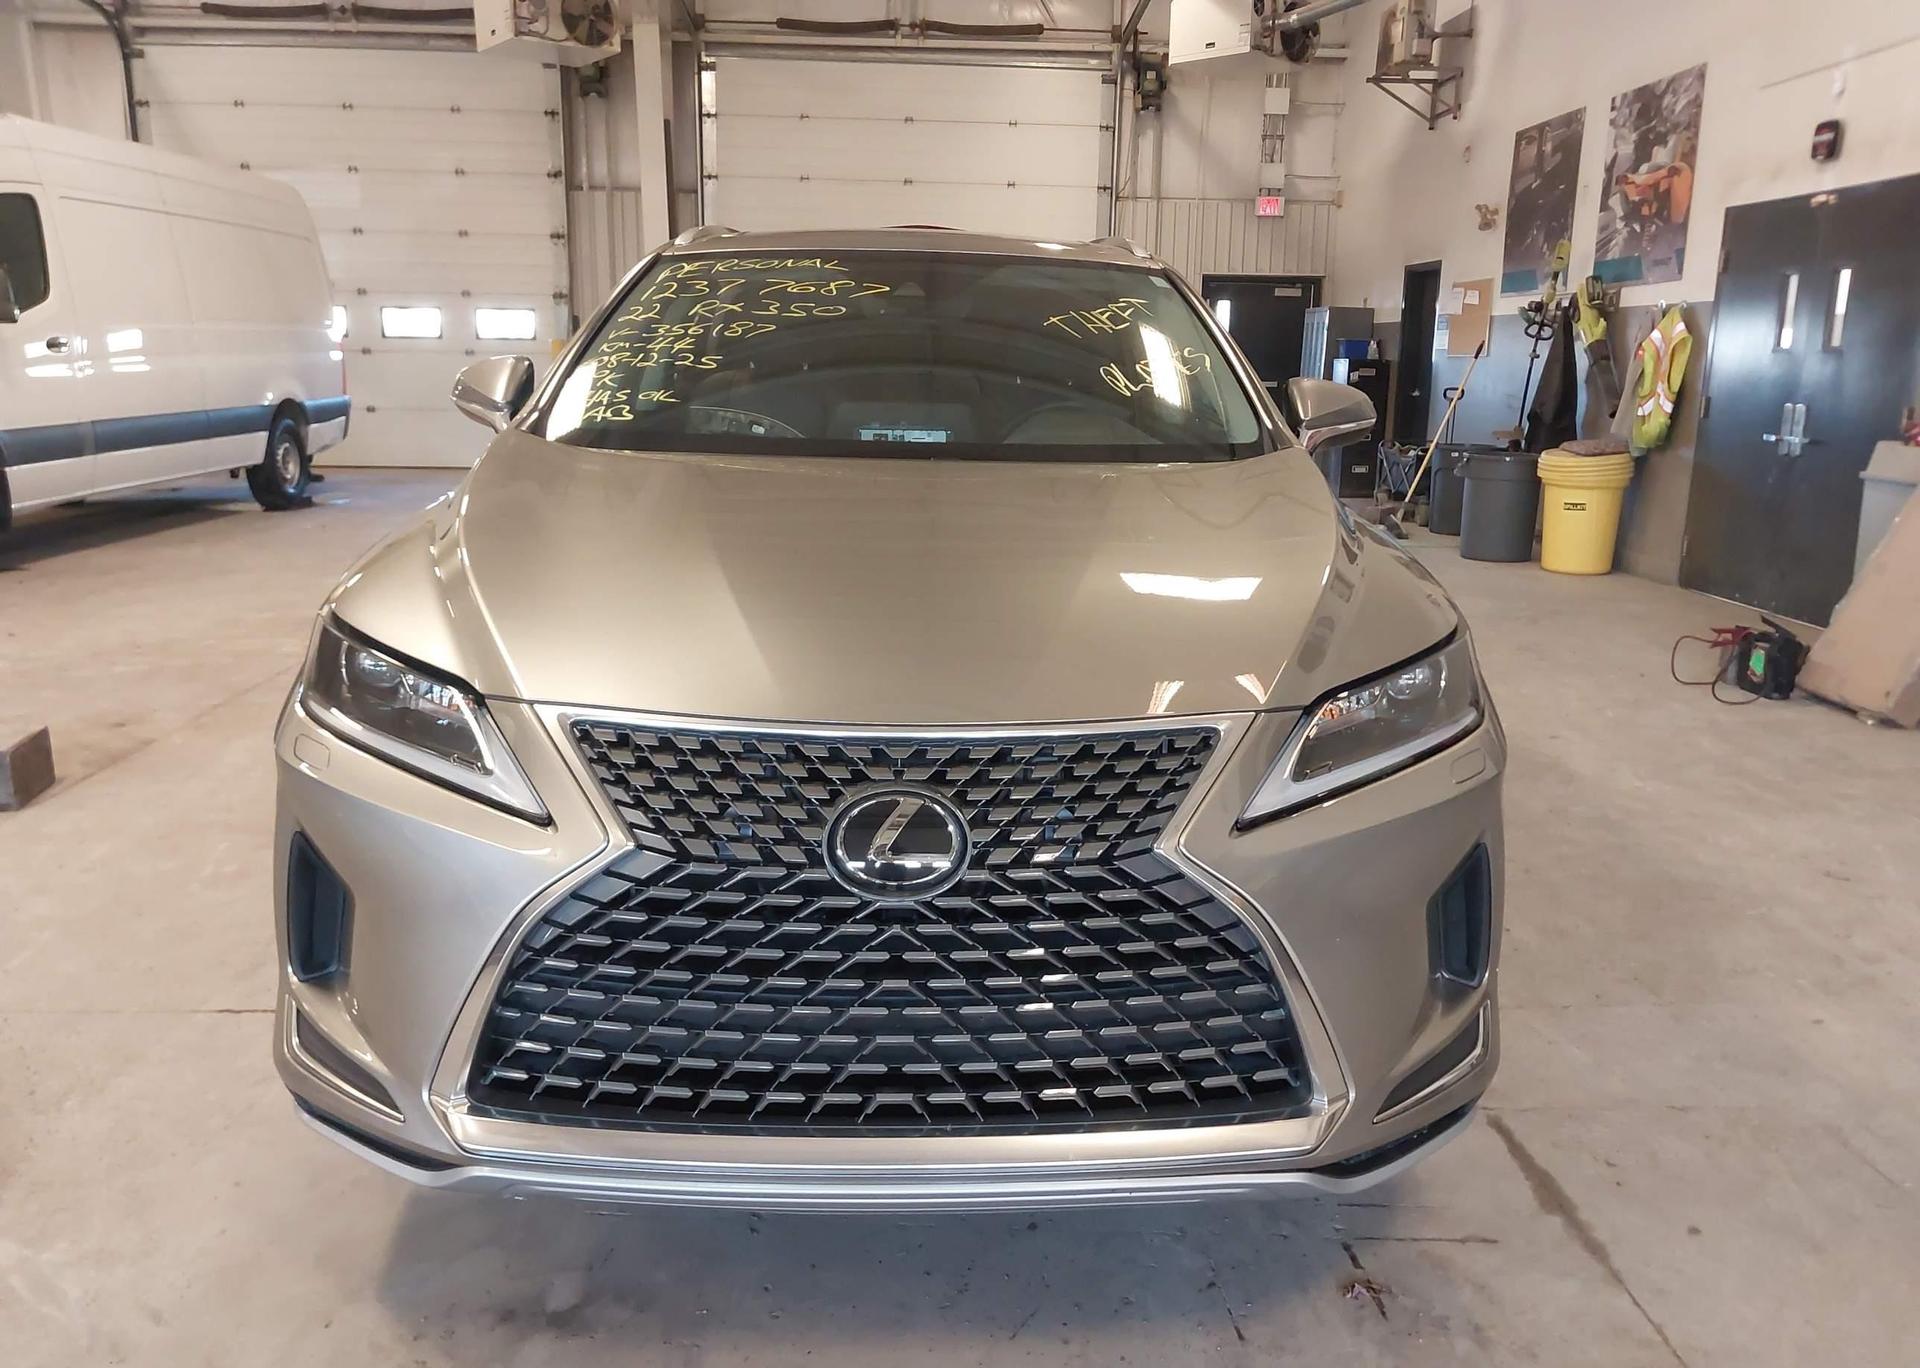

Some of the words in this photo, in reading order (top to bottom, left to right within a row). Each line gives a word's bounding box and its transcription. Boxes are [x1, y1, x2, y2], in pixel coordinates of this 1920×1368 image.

[654, 258, 849, 284] PERSONAL
[640, 278, 747, 301] 1237
[759, 279, 891, 298] 7687
[618, 303, 662, 322] 22
[687, 299, 745, 318] RX
[751, 299, 847, 317] 350
[1043, 297, 1153, 339] THEFT
